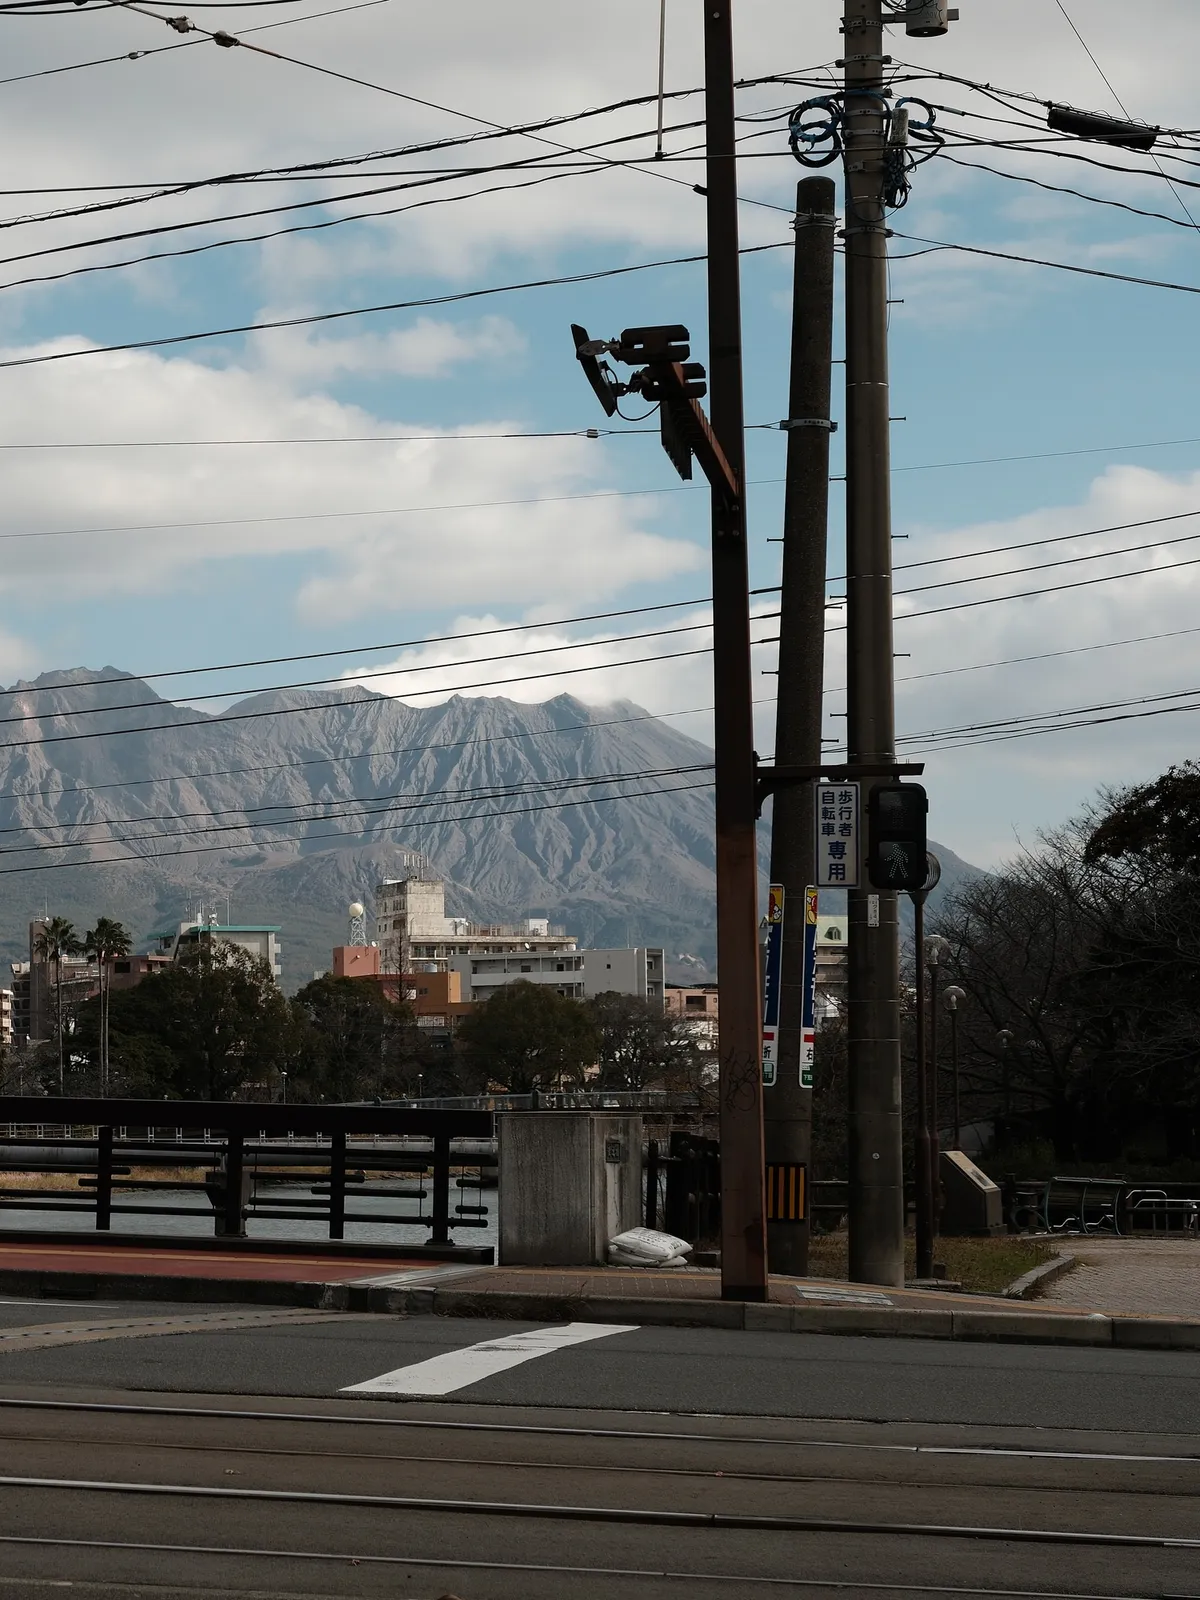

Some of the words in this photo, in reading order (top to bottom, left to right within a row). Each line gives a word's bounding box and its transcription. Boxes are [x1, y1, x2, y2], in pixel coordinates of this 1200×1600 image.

[821, 790, 836, 836] 自転車
[838, 790, 853, 836] 歩行者
[828, 840, 847, 881] 専用
